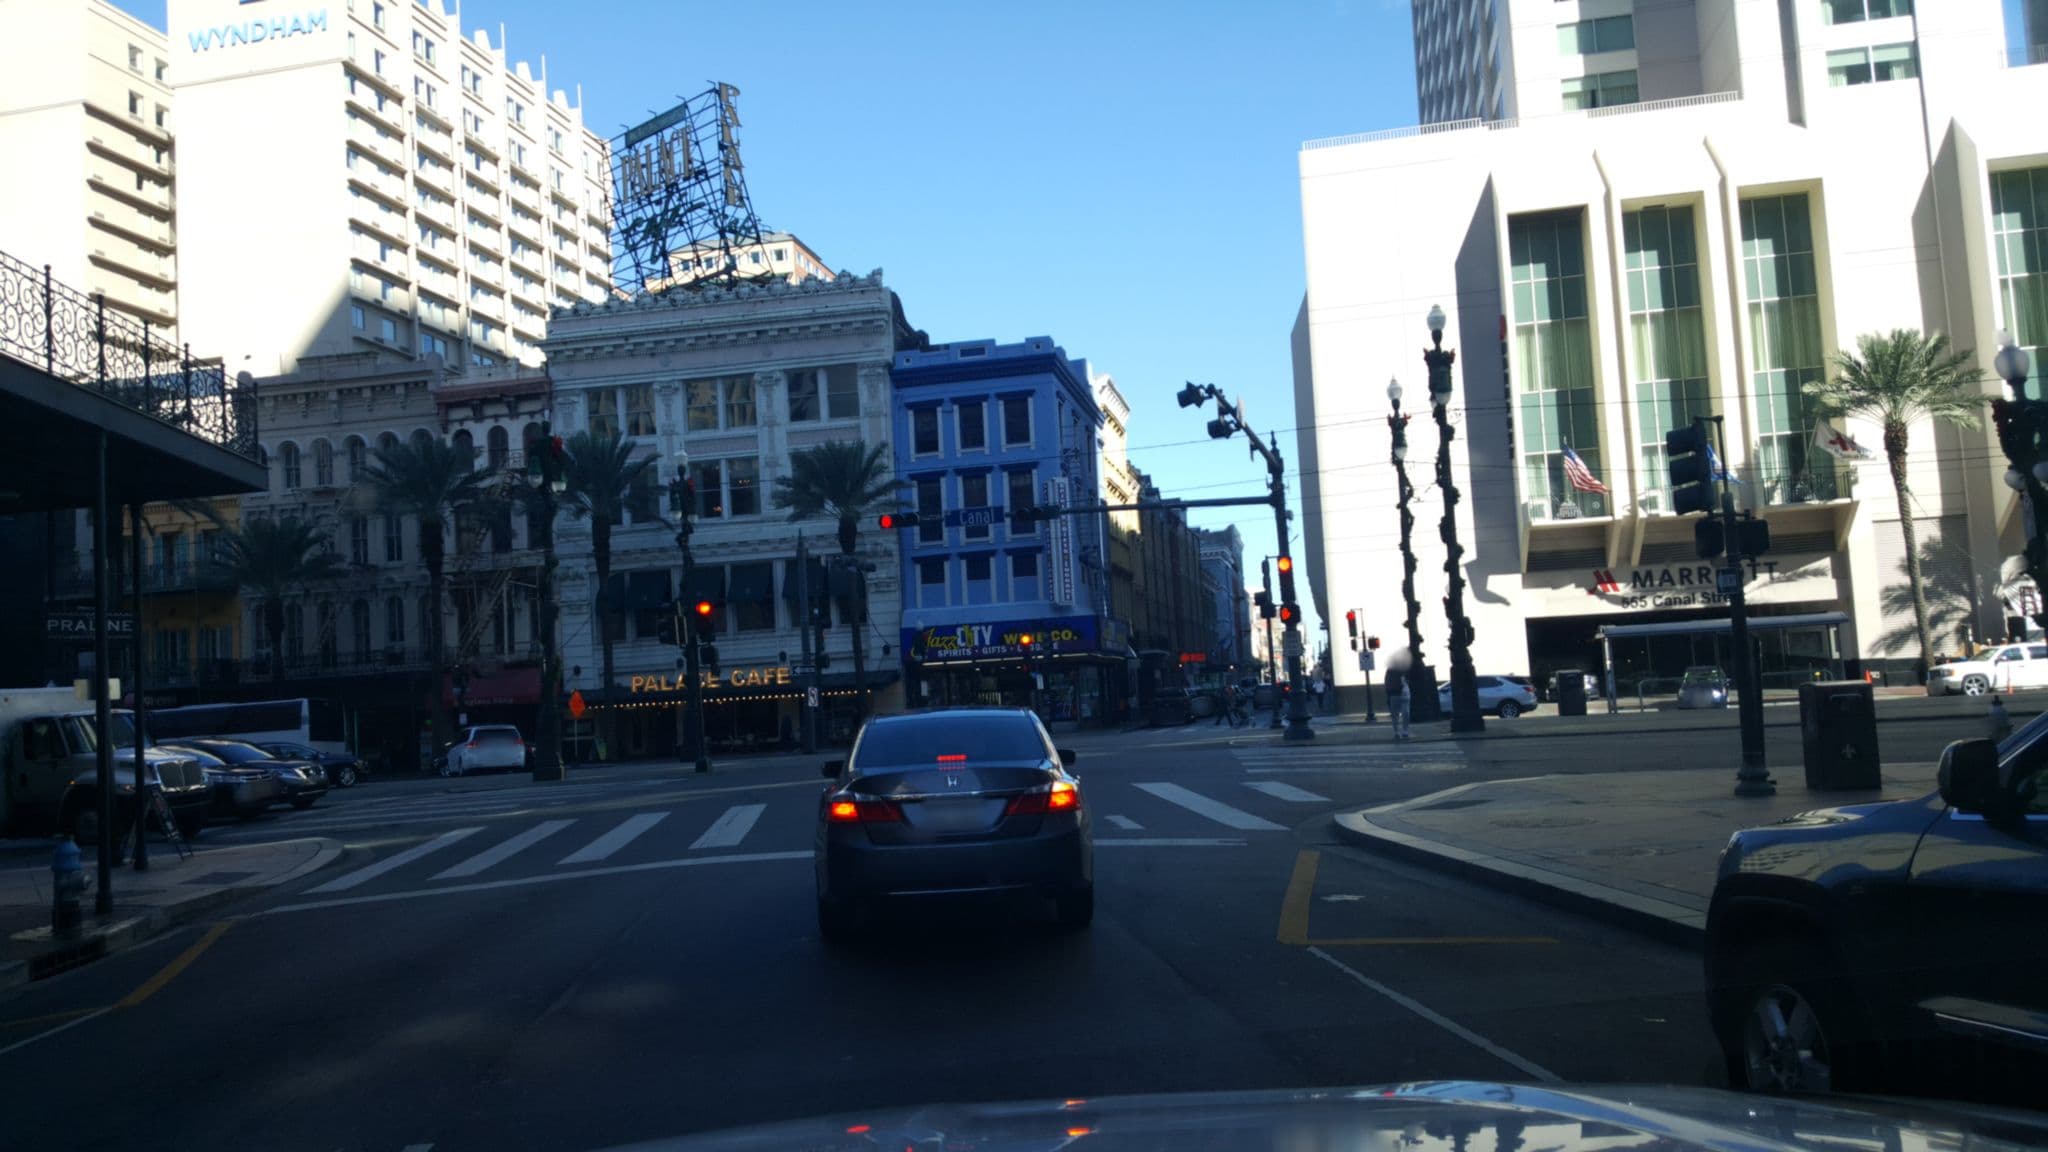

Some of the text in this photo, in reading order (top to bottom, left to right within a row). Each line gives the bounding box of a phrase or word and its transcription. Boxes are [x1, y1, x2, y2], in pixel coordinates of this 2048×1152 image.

[188, 8, 328, 53] WYNDHAM
[960, 508, 994, 526] Canal
[1632, 563, 1778, 588] MARRTT
[1621, 595, 1648, 609] 555
[1653, 592, 1696, 607] Canal
[47, 619, 134, 632] PRALNE
[1051, 629, 1078, 641] CO.
[937, 648, 972, 657] SPIRITS
[982, 645, 1007, 656] GIFTS
[631, 671, 721, 693] PALAE
